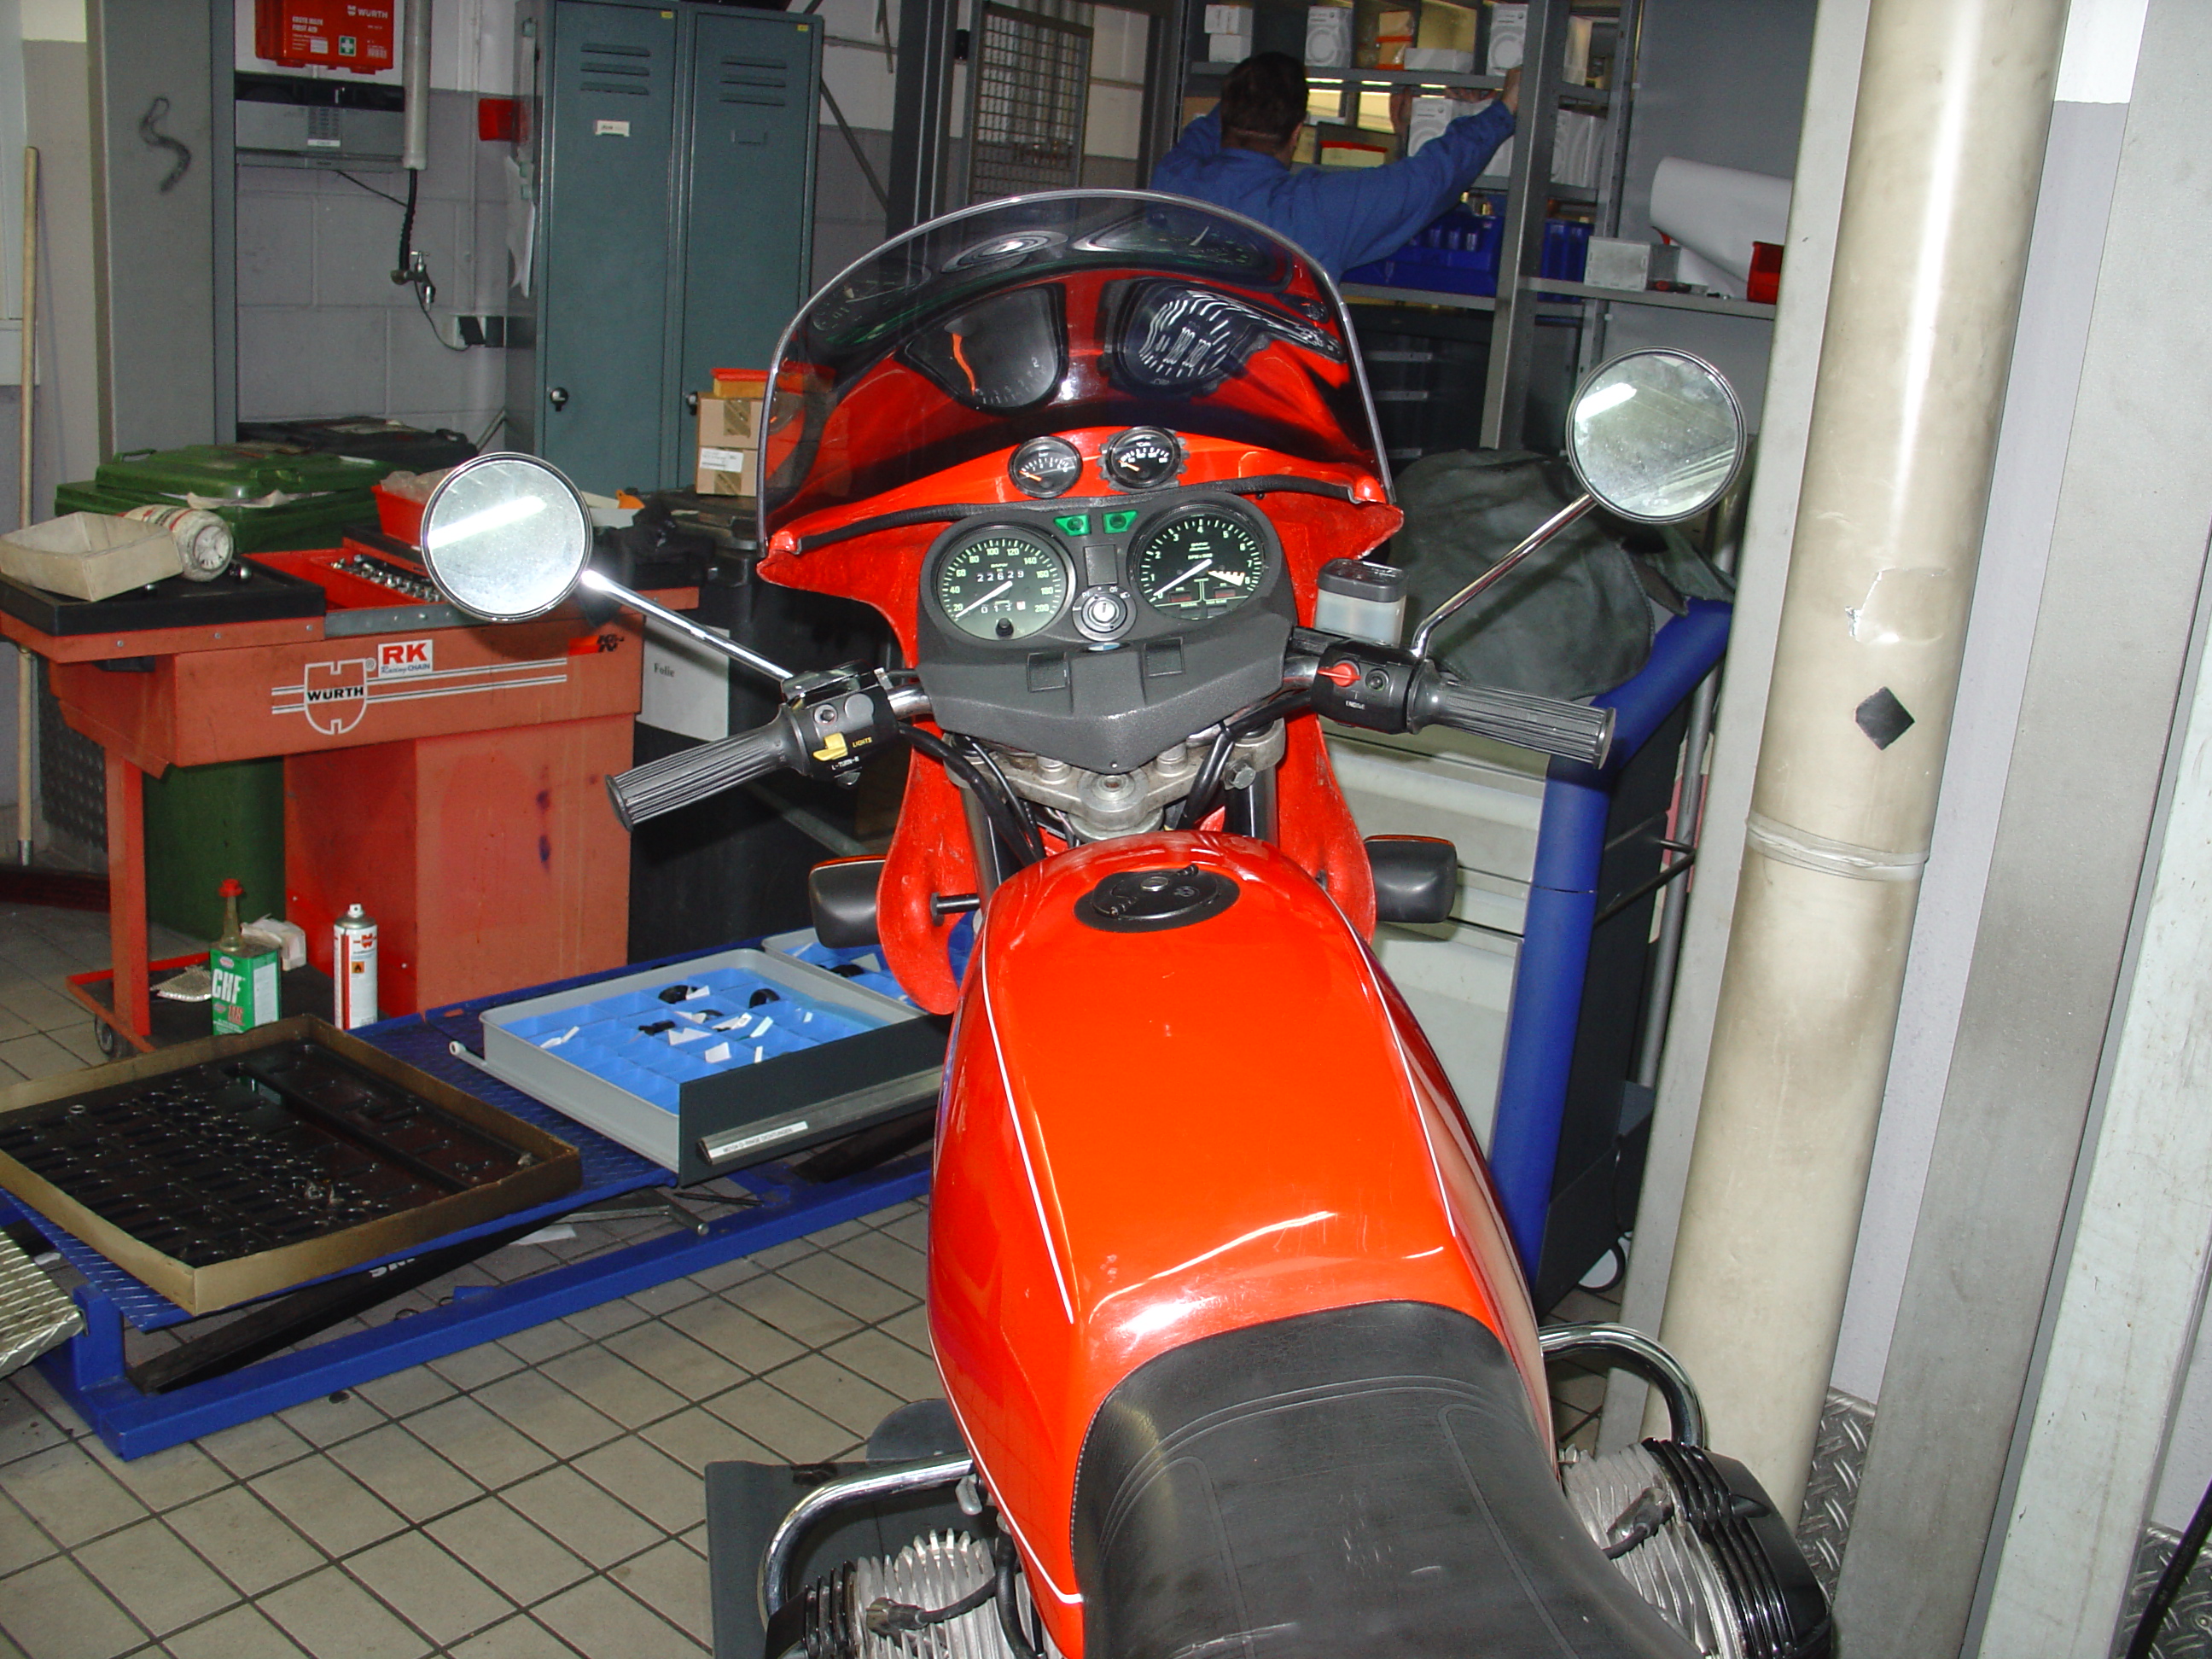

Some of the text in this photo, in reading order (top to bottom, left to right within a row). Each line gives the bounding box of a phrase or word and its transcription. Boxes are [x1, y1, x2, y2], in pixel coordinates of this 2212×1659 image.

[1007, 548, 1020, 556] 120
[1024, 556, 1037, 565] 140
[953, 602, 963, 611] 20
[1034, 603, 1050, 613] 200
[382, 643, 428, 665] RK
[407, 663, 431, 672] CHAIN
[654, 662, 675, 678] Folie
[852, 736, 872, 748] LIGHTS
[212, 968, 242, 1004] CHF
